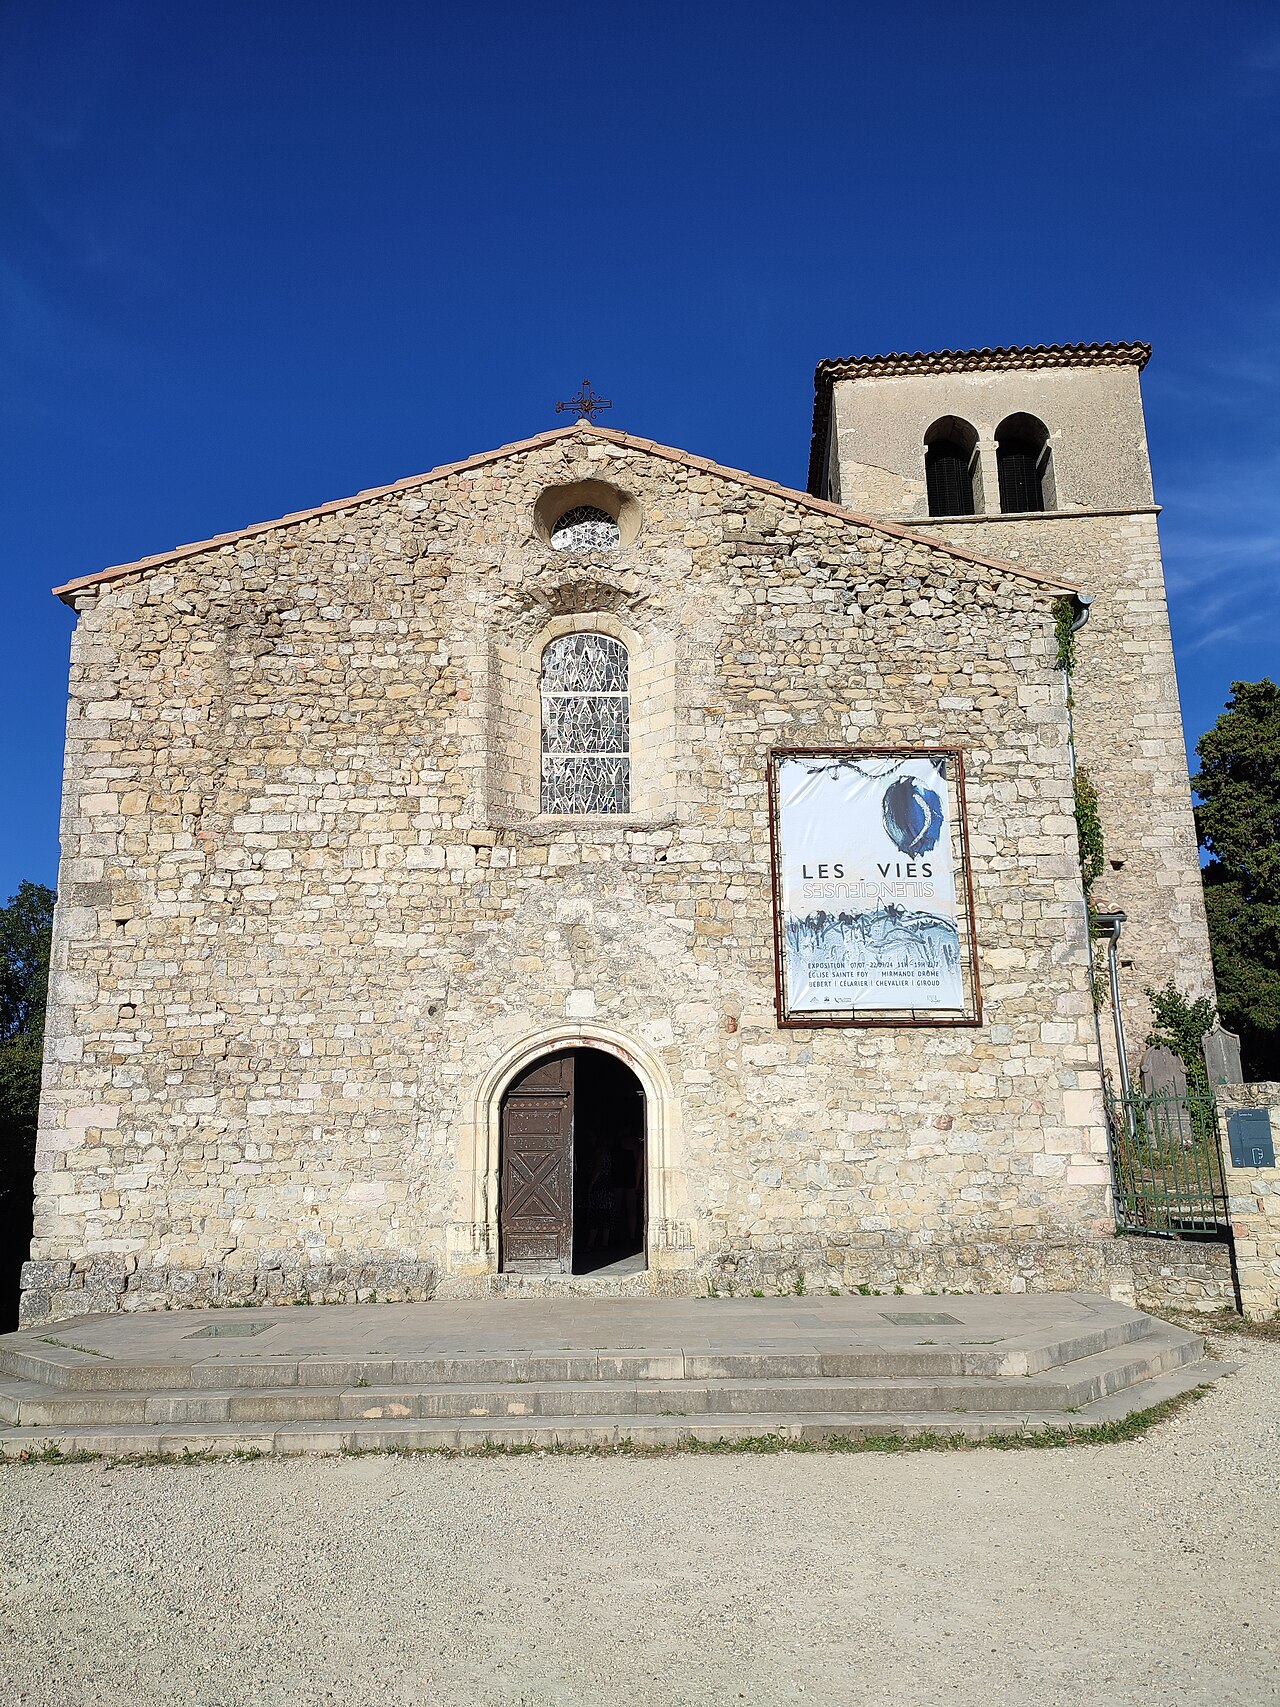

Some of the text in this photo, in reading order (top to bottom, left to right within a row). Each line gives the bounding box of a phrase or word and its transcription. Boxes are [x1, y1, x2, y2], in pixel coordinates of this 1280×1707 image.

[802, 863, 933, 879] LES VIES
[803, 881, 935, 898] SILENCIEUSES
[808, 970, 829, 978] ÉGLISE
[839, 979, 868, 987] CÉLARIER
